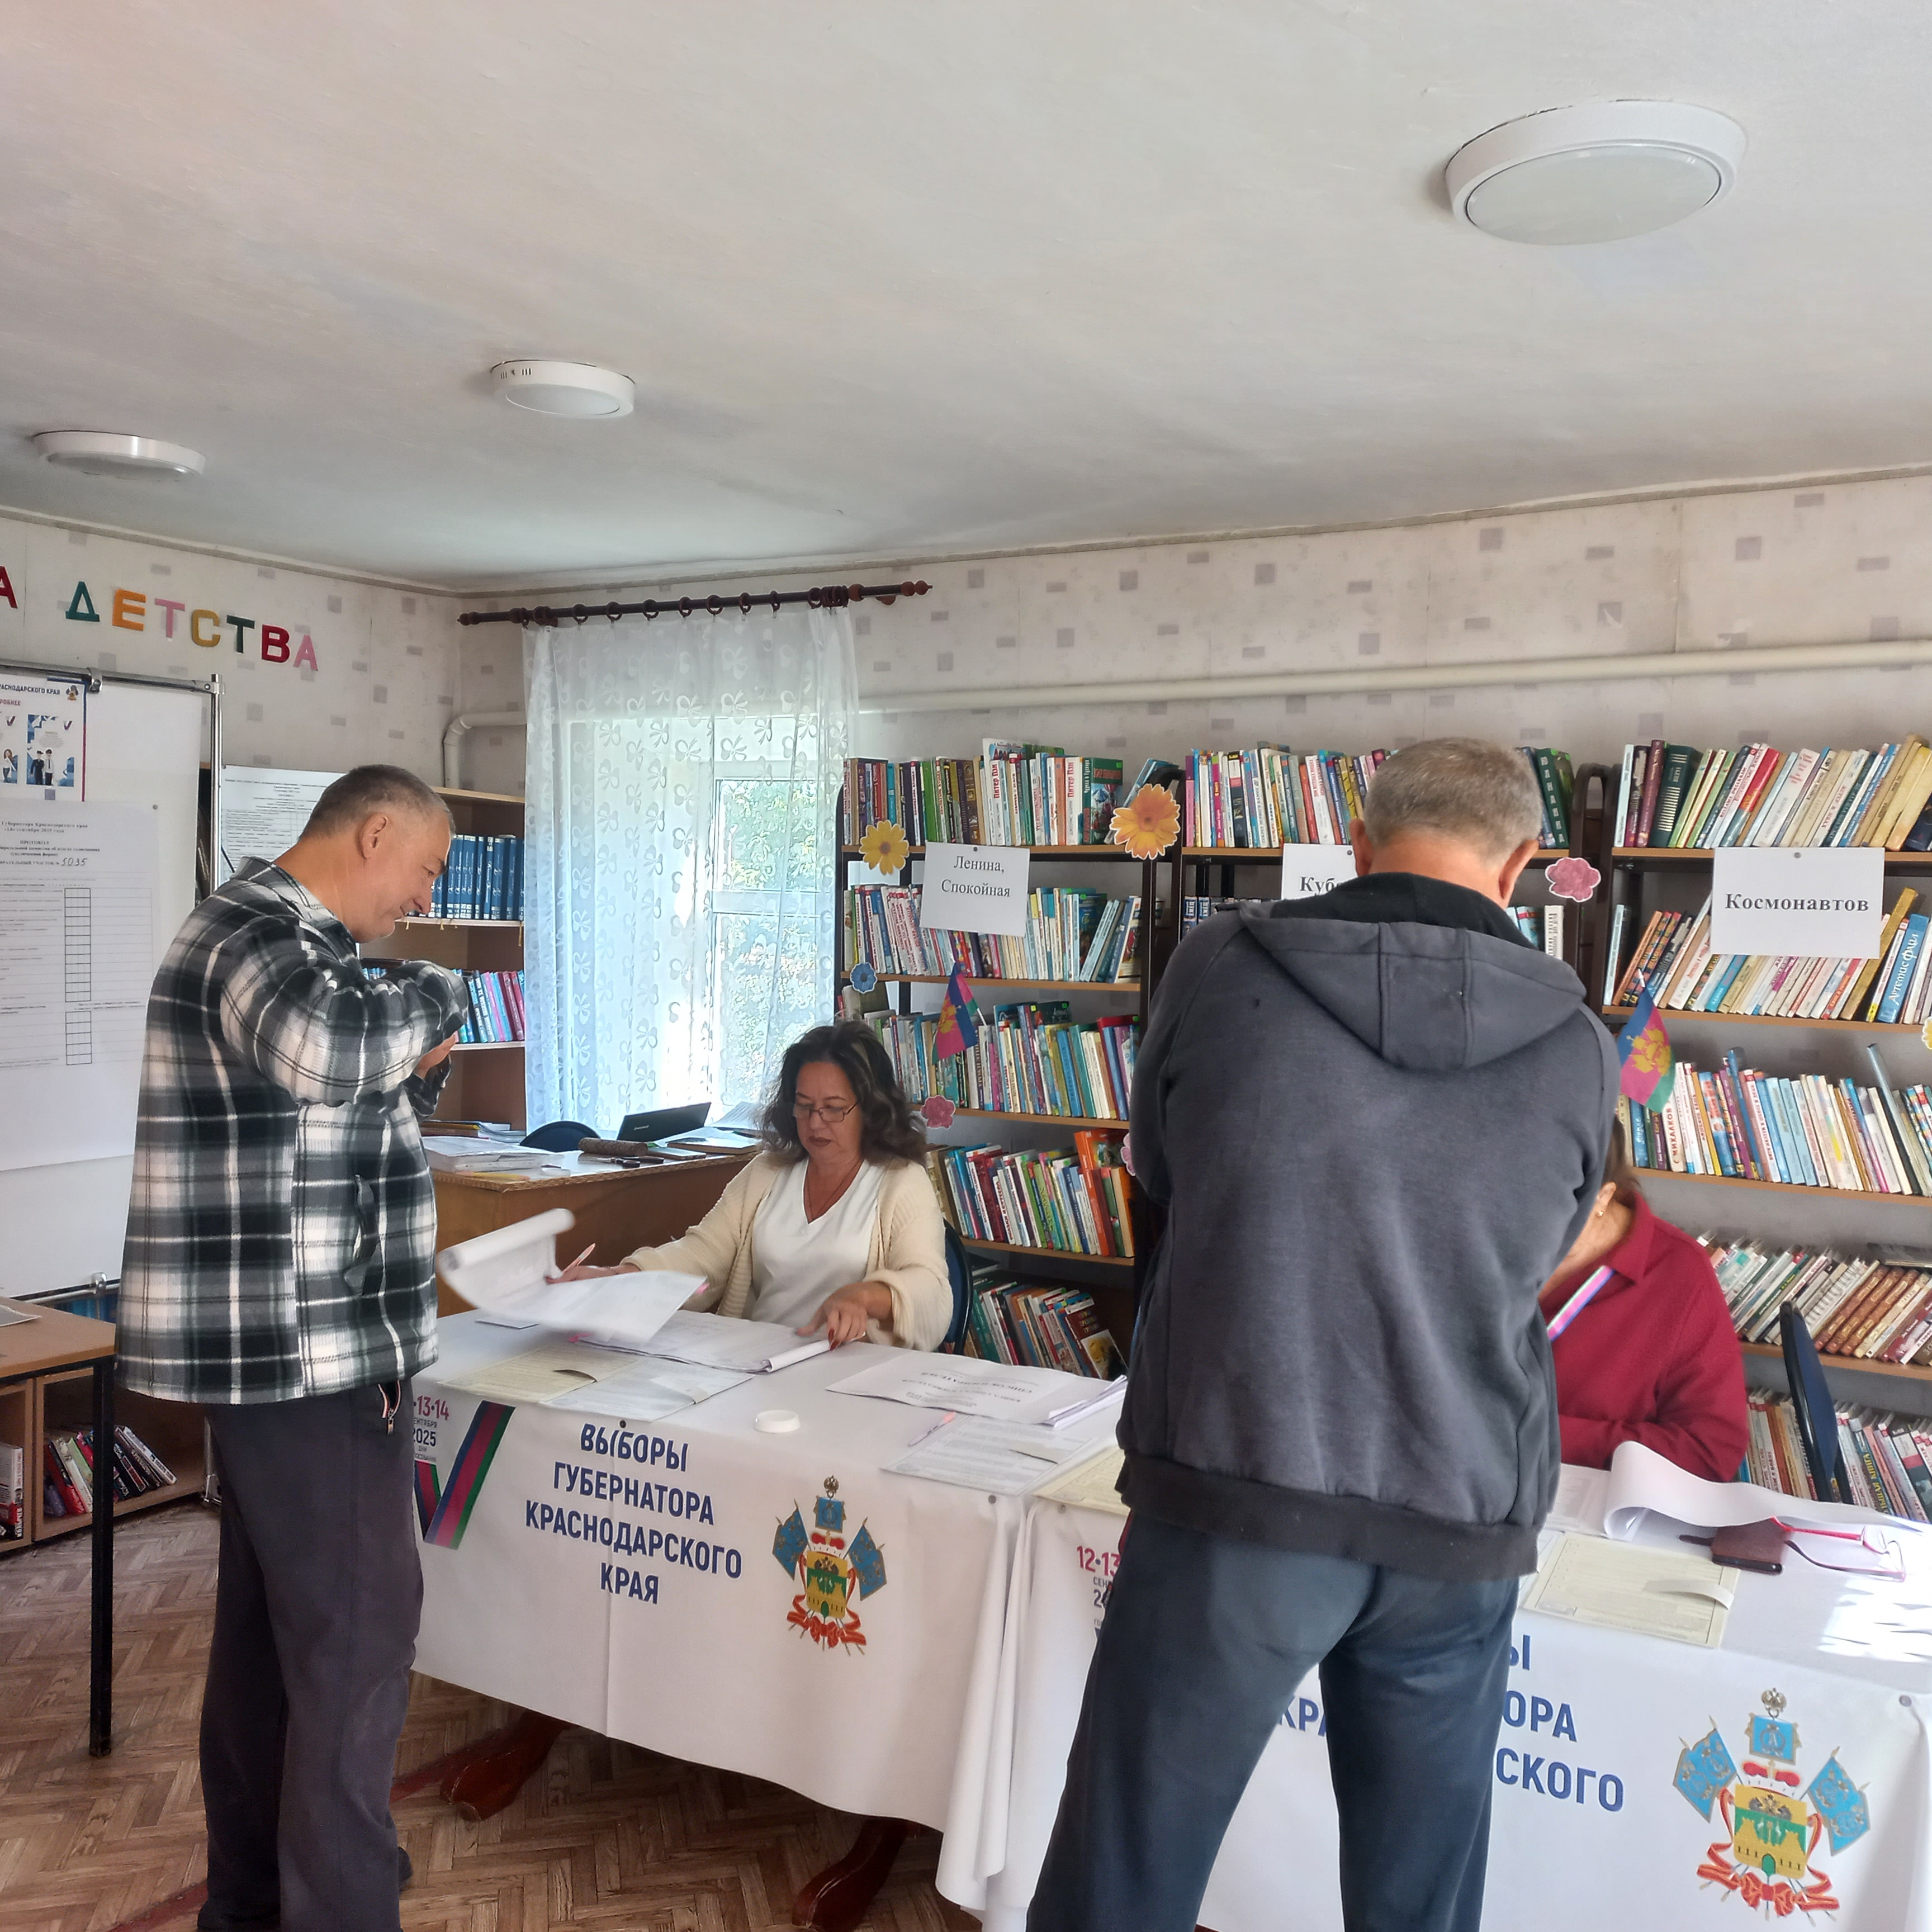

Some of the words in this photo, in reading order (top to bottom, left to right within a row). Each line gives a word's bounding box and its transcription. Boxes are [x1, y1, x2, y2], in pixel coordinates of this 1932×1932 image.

[65, 581, 318, 671] ДЕТСТВА
[0, 684, 45, 694] АСНОДАРСКОГО
[61, 857, 88, 866] 5035
[954, 856, 1005, 874] Ленина,
[941, 879, 1010, 898] Спокойная
[1725, 893, 1869, 912] Космонавтов
[1664, 1107, 1680, 1157] МИХАЛКОВ
[414, 1417, 437, 1428] ЕНТЯБРЯ
[580, 1423, 688, 1472] ВЫБОРЫ
[553, 1461, 714, 1525] ГУБЕРНАТОРА
[525, 1500, 742, 1579] КРАСНОДАРСКОГО
[600, 1562, 659, 1604] КРАЯ
[1509, 1634, 1531, 1671] Ы
[1503, 1689, 1578, 1742] ОРА
[1497, 1748, 1625, 1813] СКОГО
